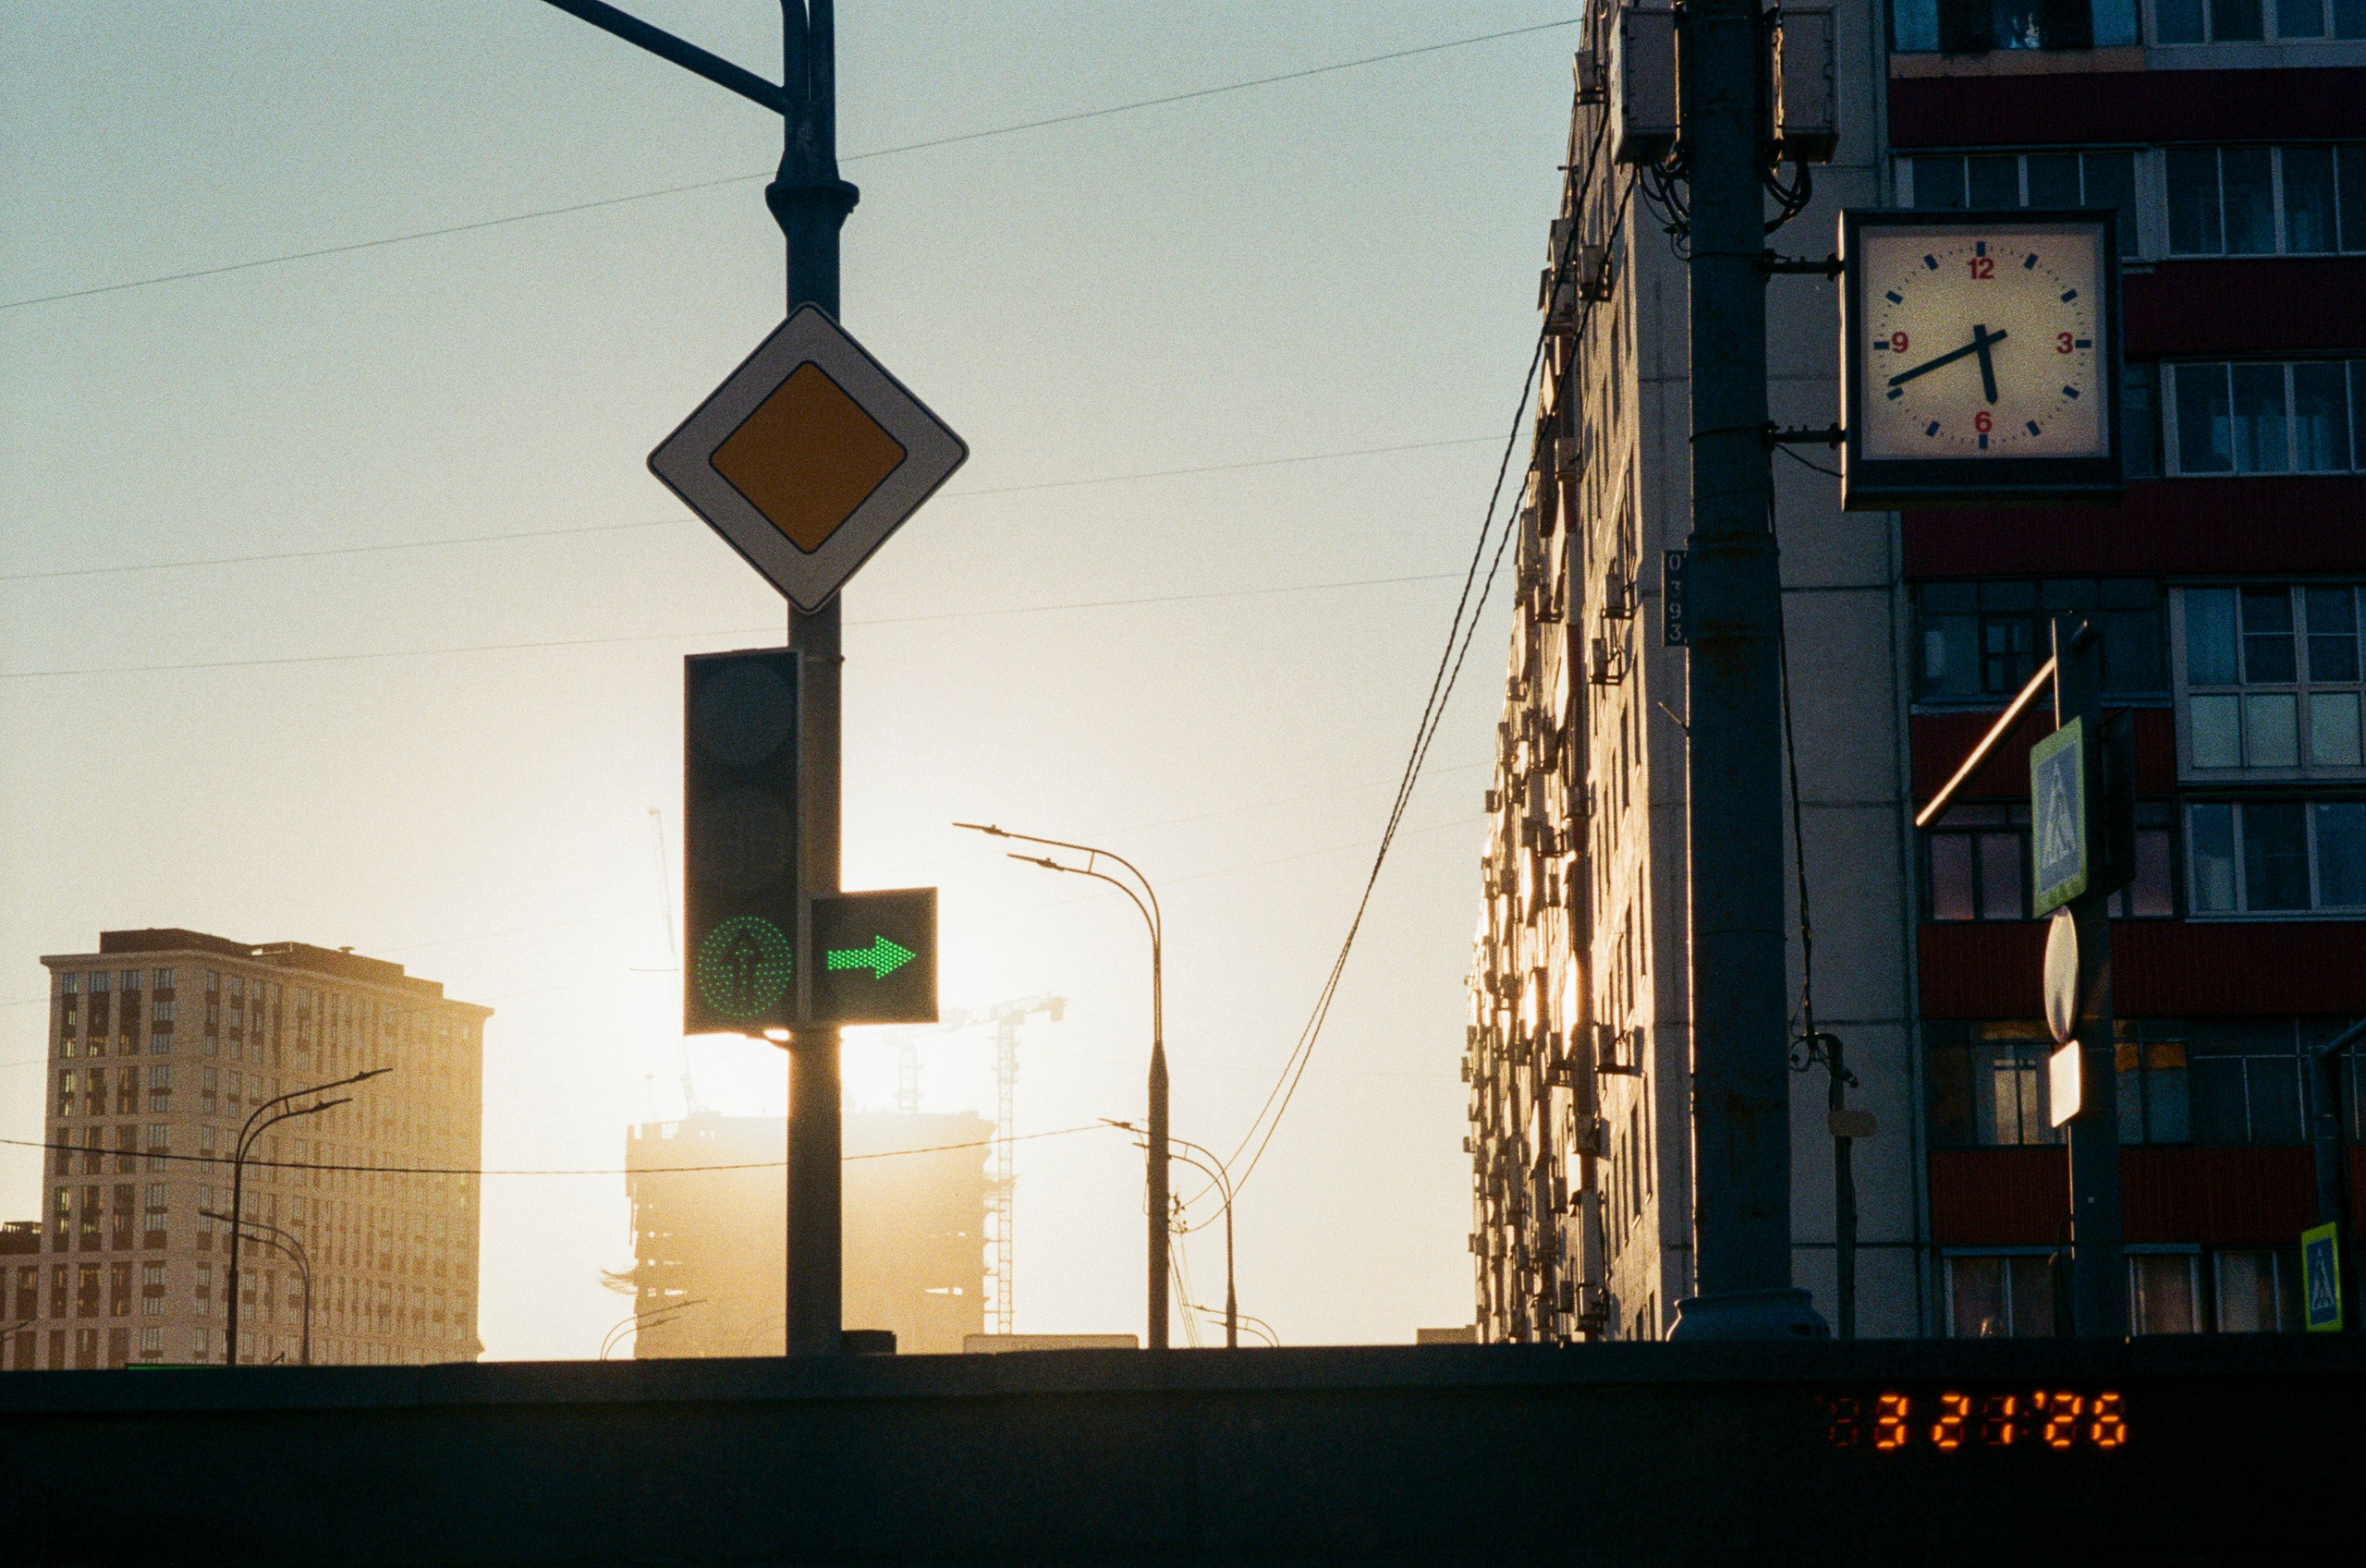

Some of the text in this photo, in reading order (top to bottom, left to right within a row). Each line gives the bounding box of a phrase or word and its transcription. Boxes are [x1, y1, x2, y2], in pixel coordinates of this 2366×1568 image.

[1968, 258, 1994, 279] 12
[1892, 332, 1909, 353] 9
[2056, 333, 2074, 354] 3
[1974, 411, 1993, 433] 6
